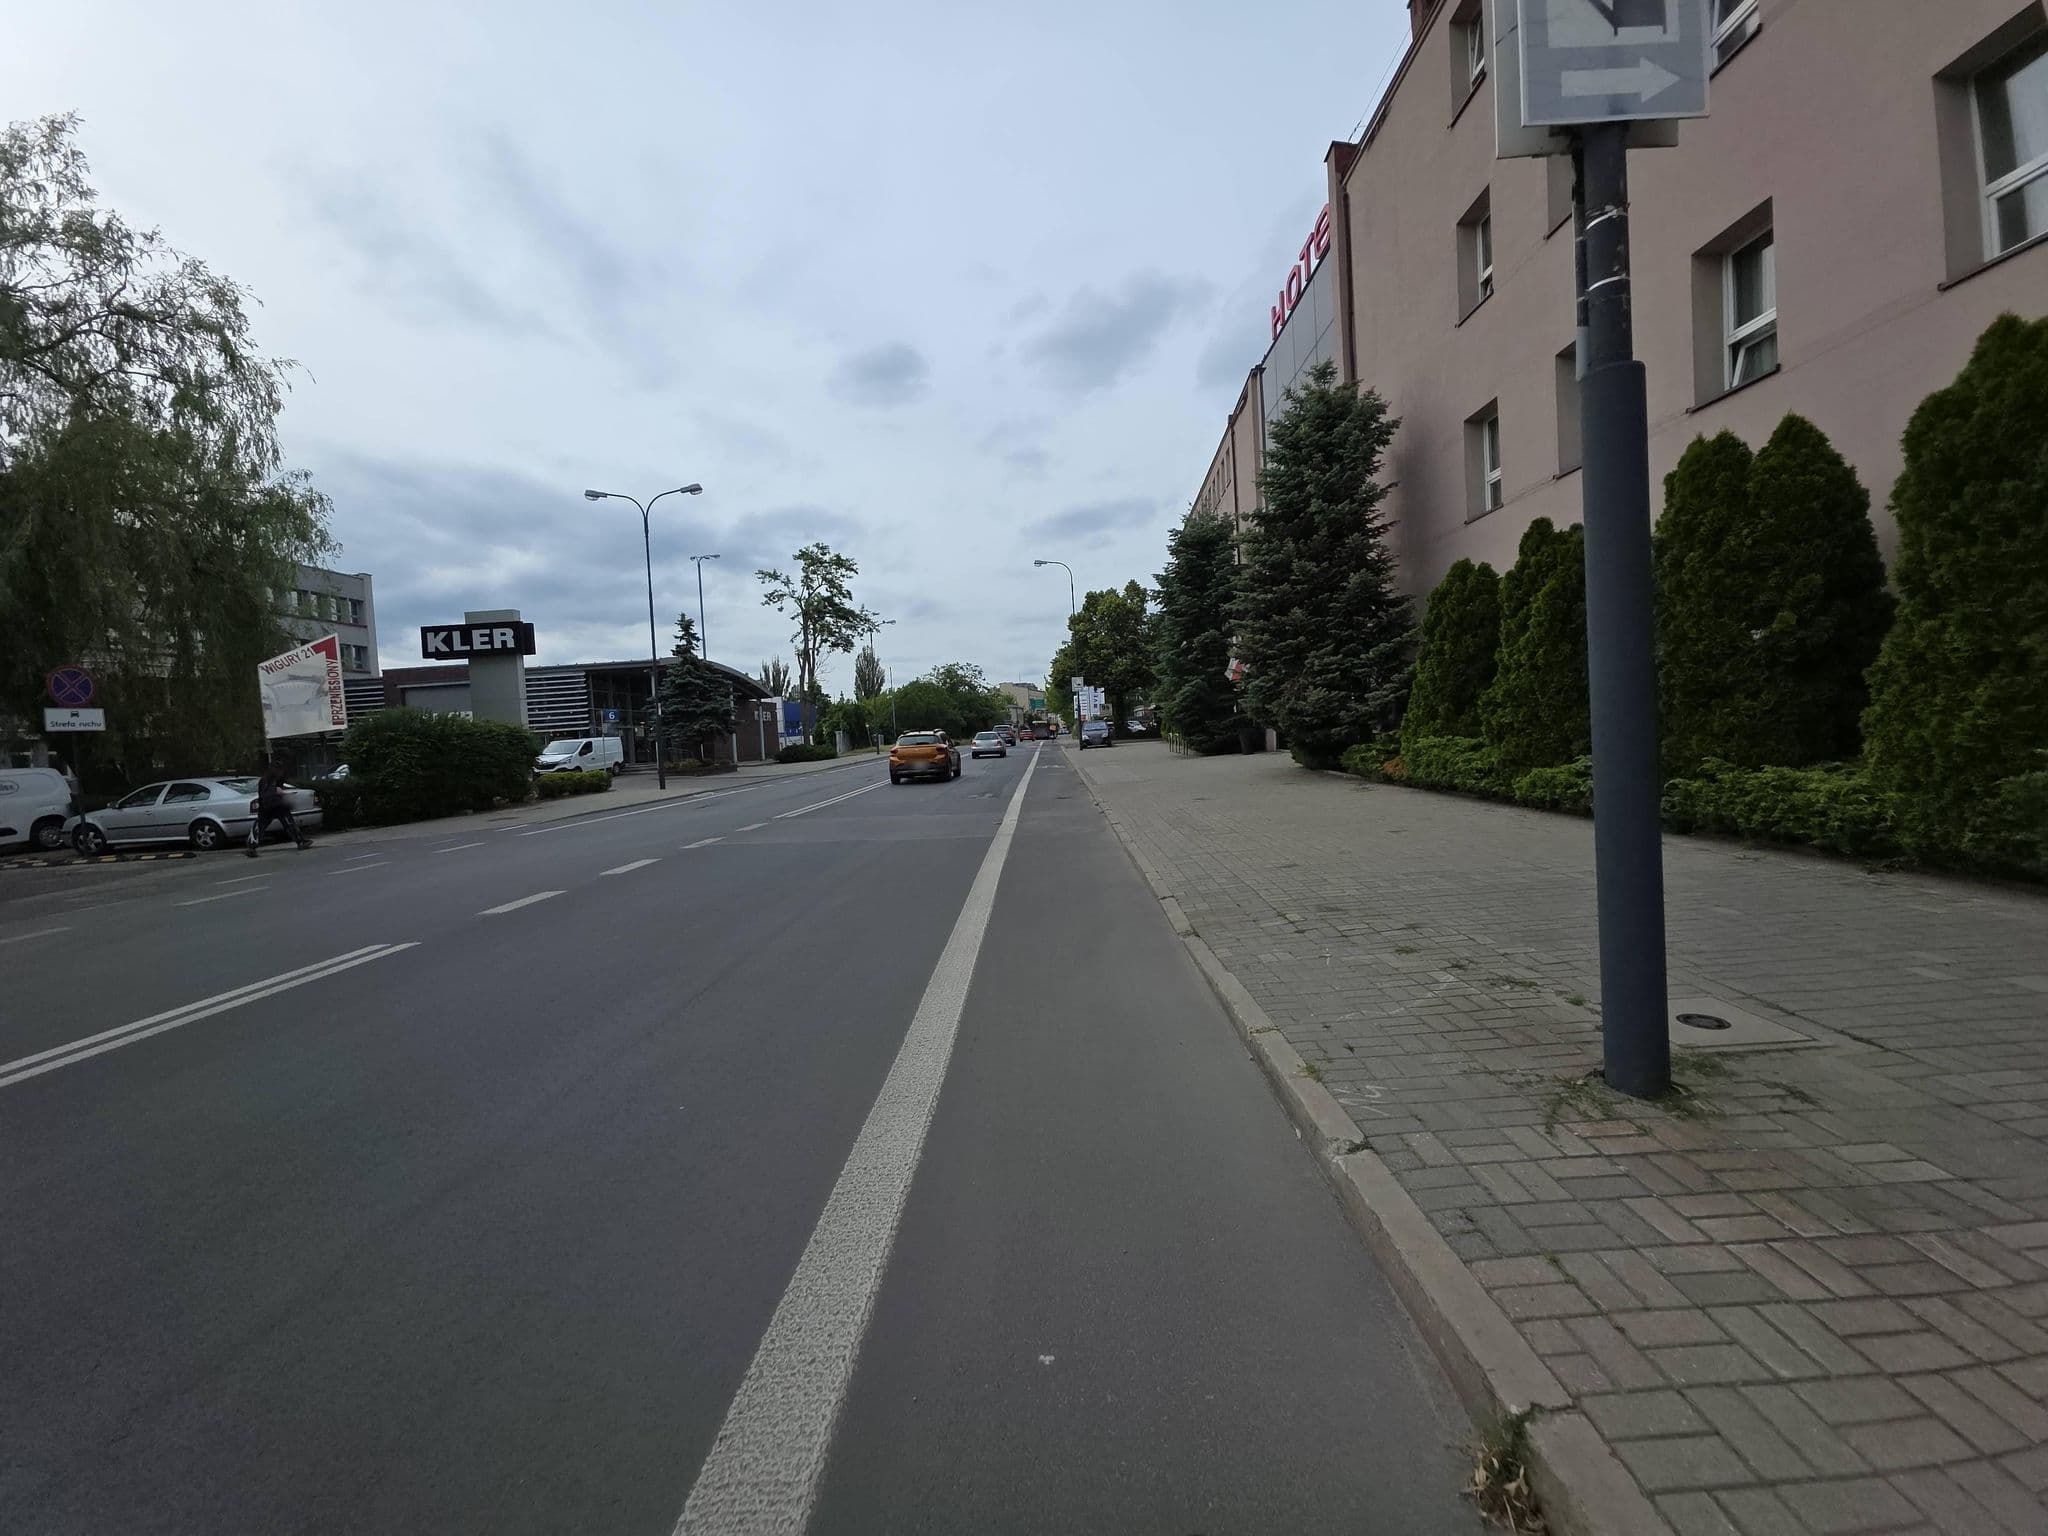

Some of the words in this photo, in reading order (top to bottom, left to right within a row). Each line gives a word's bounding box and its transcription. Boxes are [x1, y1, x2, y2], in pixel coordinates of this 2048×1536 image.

[426, 628, 516, 652] KLER
[260, 653, 302, 675] WIGURY
[301, 648, 315, 659] 21
[326, 660, 344, 721] PRZENIESIONY
[50, 720, 76, 728] Strefa
[79, 720, 102, 728] ruchu
[608, 711, 616, 720] 6
[754, 711, 772, 721] KER
